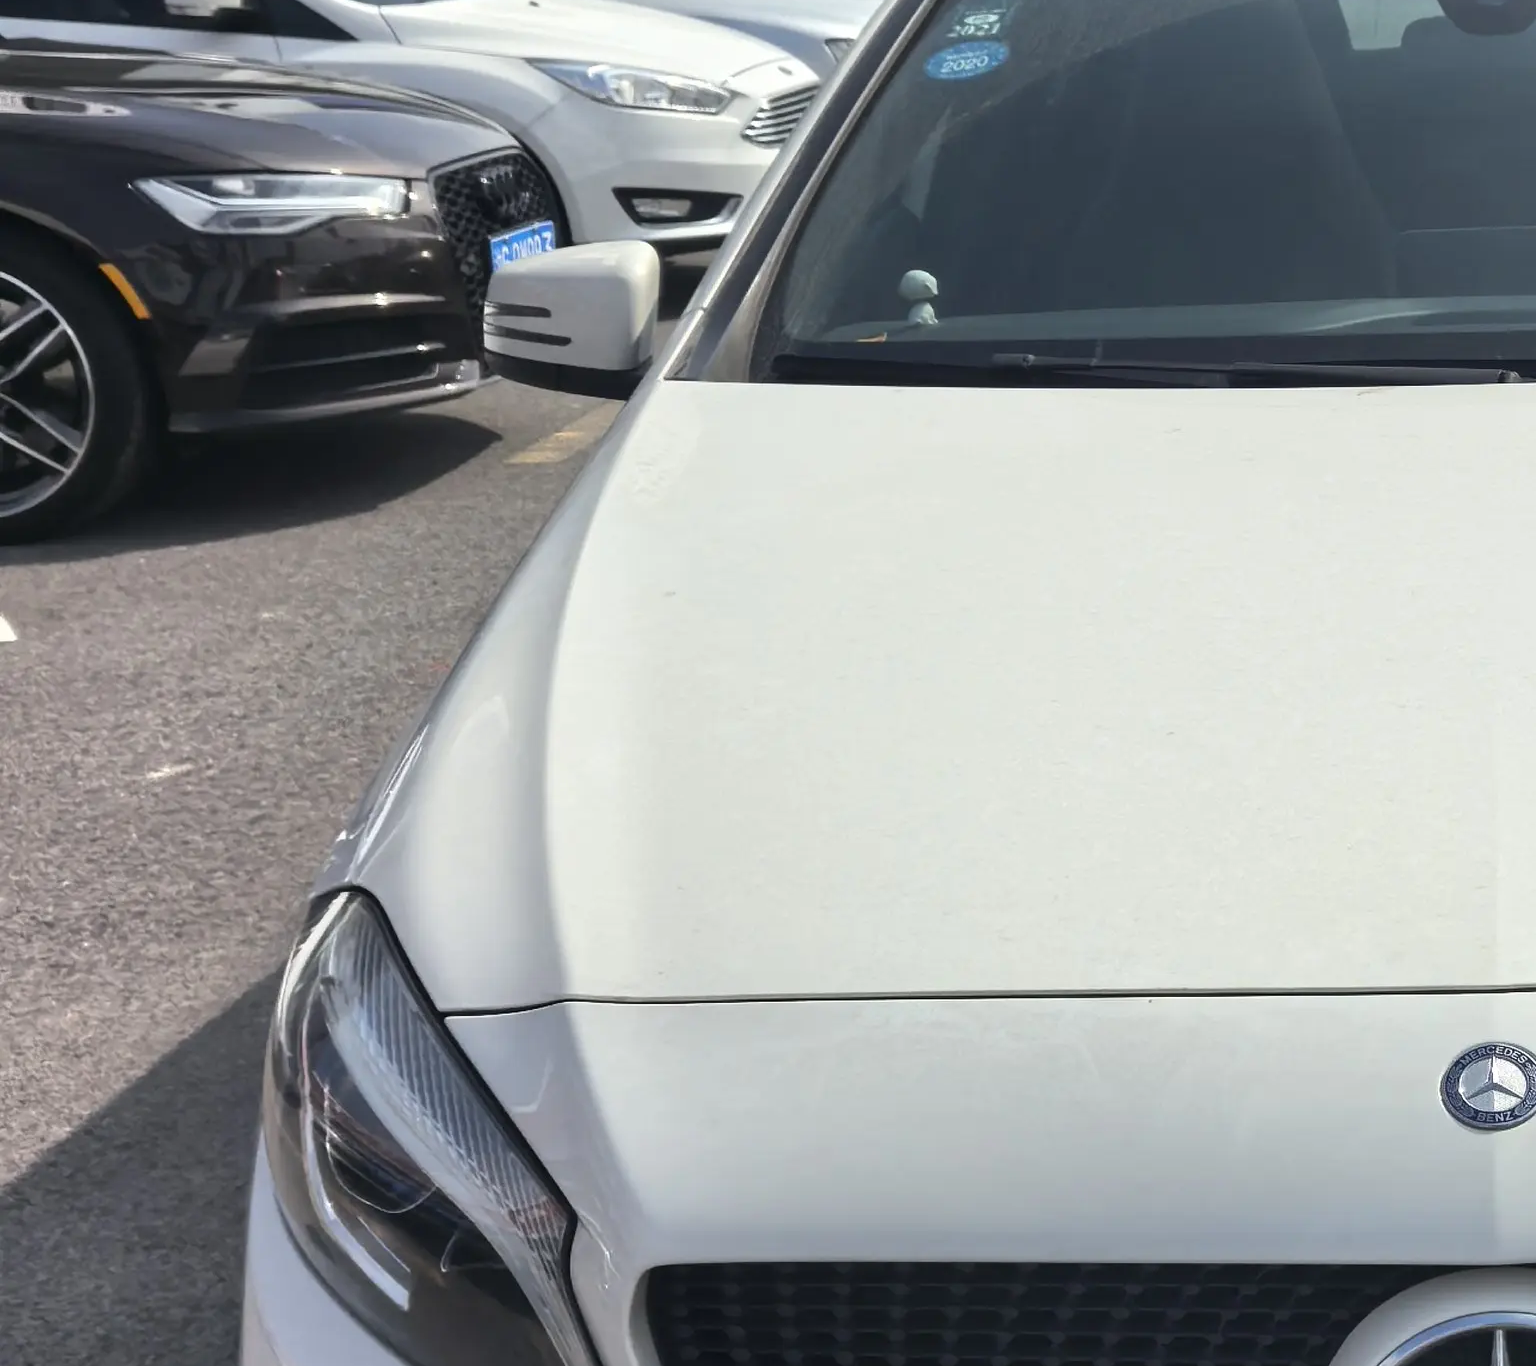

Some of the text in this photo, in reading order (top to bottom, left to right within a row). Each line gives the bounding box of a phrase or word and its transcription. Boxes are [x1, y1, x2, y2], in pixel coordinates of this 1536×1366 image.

[940, 55, 989, 73] 2020
[1460, 1045, 1528, 1066] MERCEDES
[1476, 1110, 1515, 1122] BENZ
